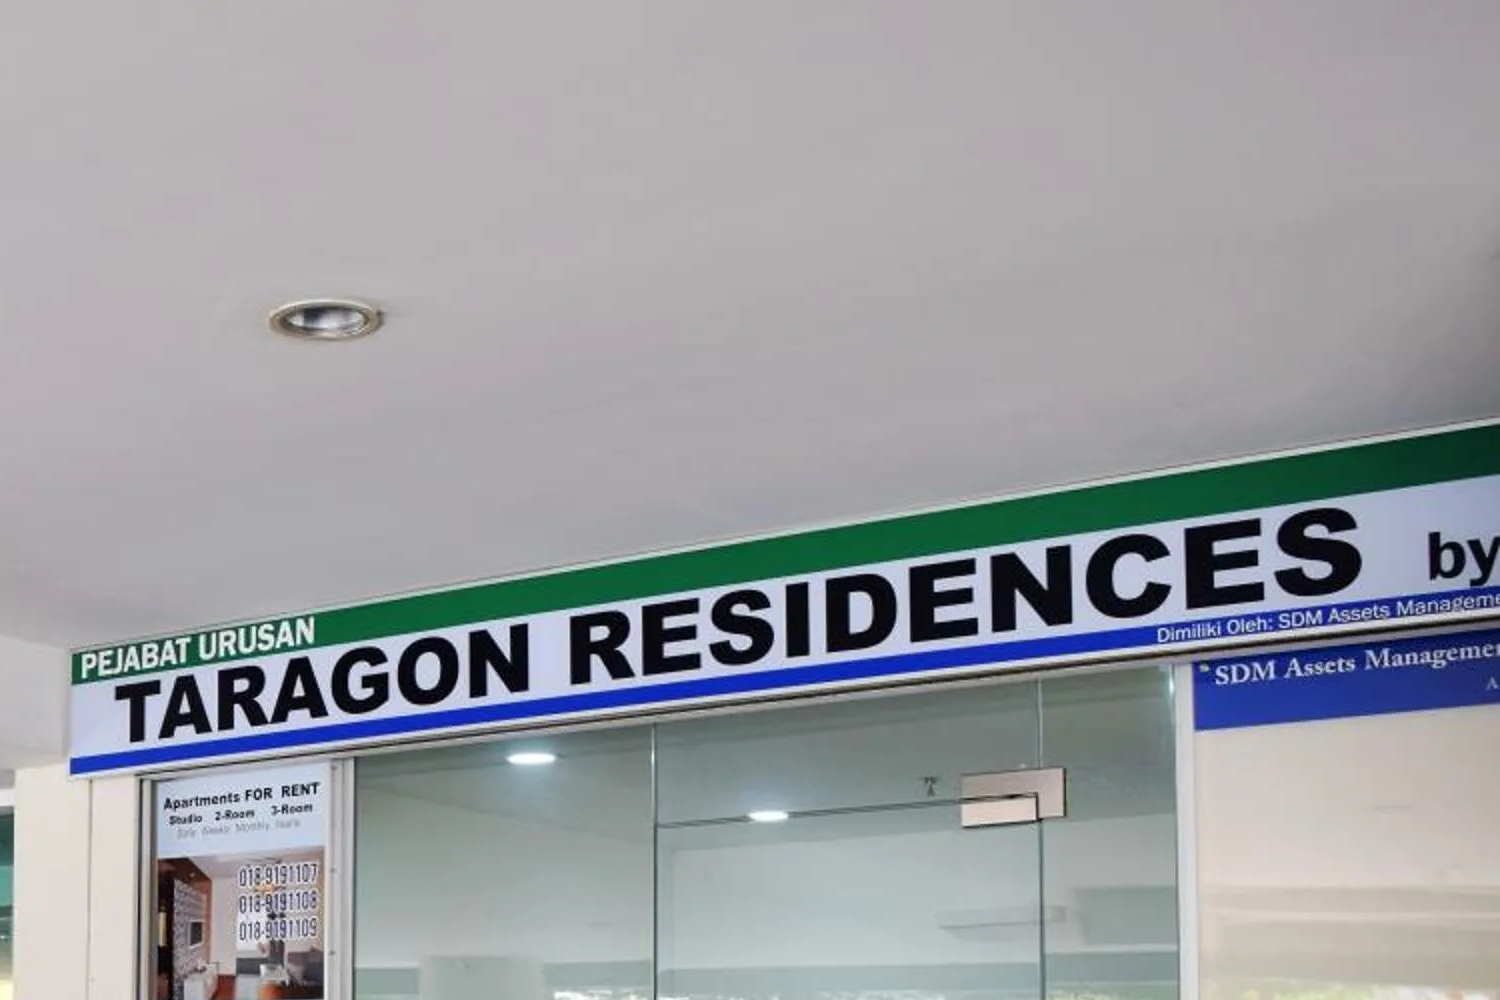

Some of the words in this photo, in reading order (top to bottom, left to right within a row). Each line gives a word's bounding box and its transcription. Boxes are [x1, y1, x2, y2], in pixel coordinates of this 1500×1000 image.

[114, 622, 530, 743] TARAGON
[569, 506, 1363, 685] RESIDENCES
[1428, 531, 1500, 587] by
[1157, 621, 1221, 643] Dimiliki
[1227, 617, 1274, 636] Oleh:
[1278, 608, 1323, 630] SDM
[1328, 601, 1390, 623] Assets
[81, 636, 192, 679] PEJABAT
[200, 616, 315, 661] URUSAN
[1214, 658, 1276, 686] SDM
[1284, 656, 1356, 679] Assets
[164, 793, 241, 812] Apartments
[245, 787, 273, 801] FOR
[280, 781, 320, 798] RENT
[169, 813, 203, 826] Studio
[214, 809, 255, 821] 2-Room
[271, 803, 313, 816] 3-Room
[239, 863, 317, 887] 018-9191107
[239, 890, 317, 914] 018-9191108
[239, 917, 317, 941] 018-9191109
